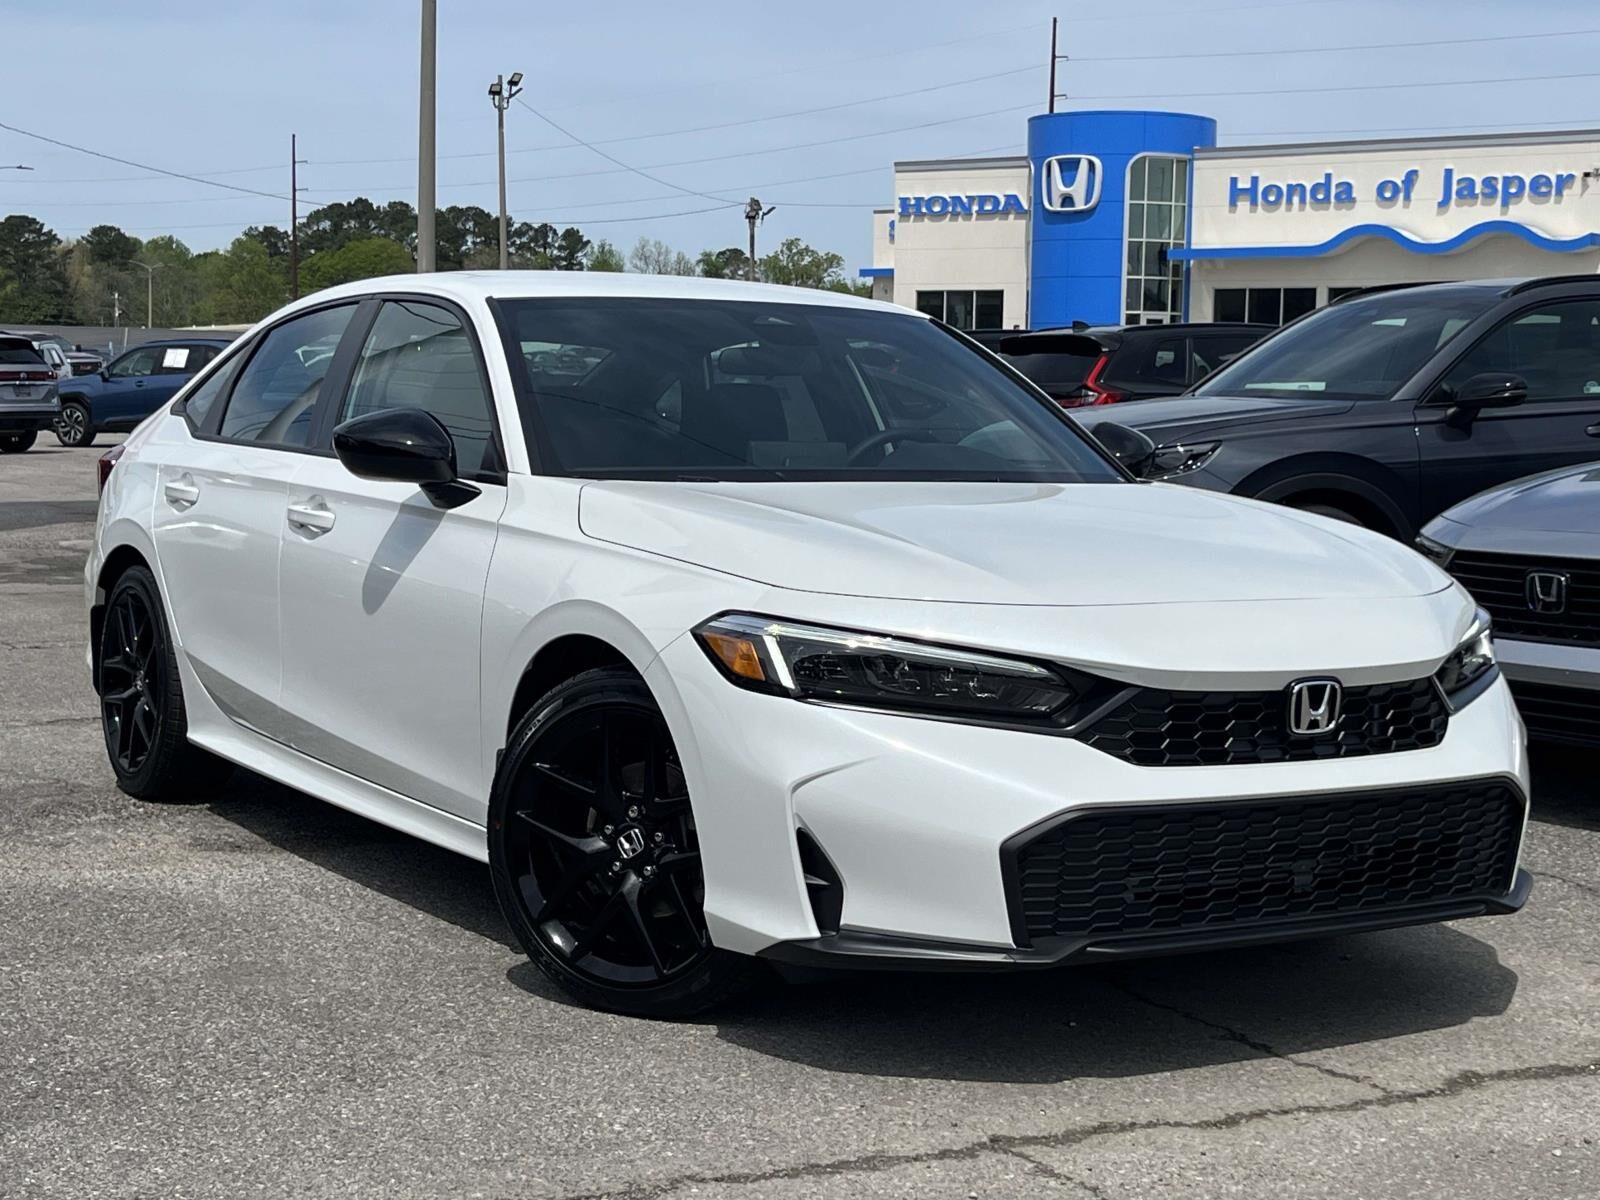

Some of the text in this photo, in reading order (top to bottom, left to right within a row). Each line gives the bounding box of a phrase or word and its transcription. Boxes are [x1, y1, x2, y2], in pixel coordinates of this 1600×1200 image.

[1229, 167, 1577, 208] Honda of Jasper
[898, 194, 1029, 216] HONDA
